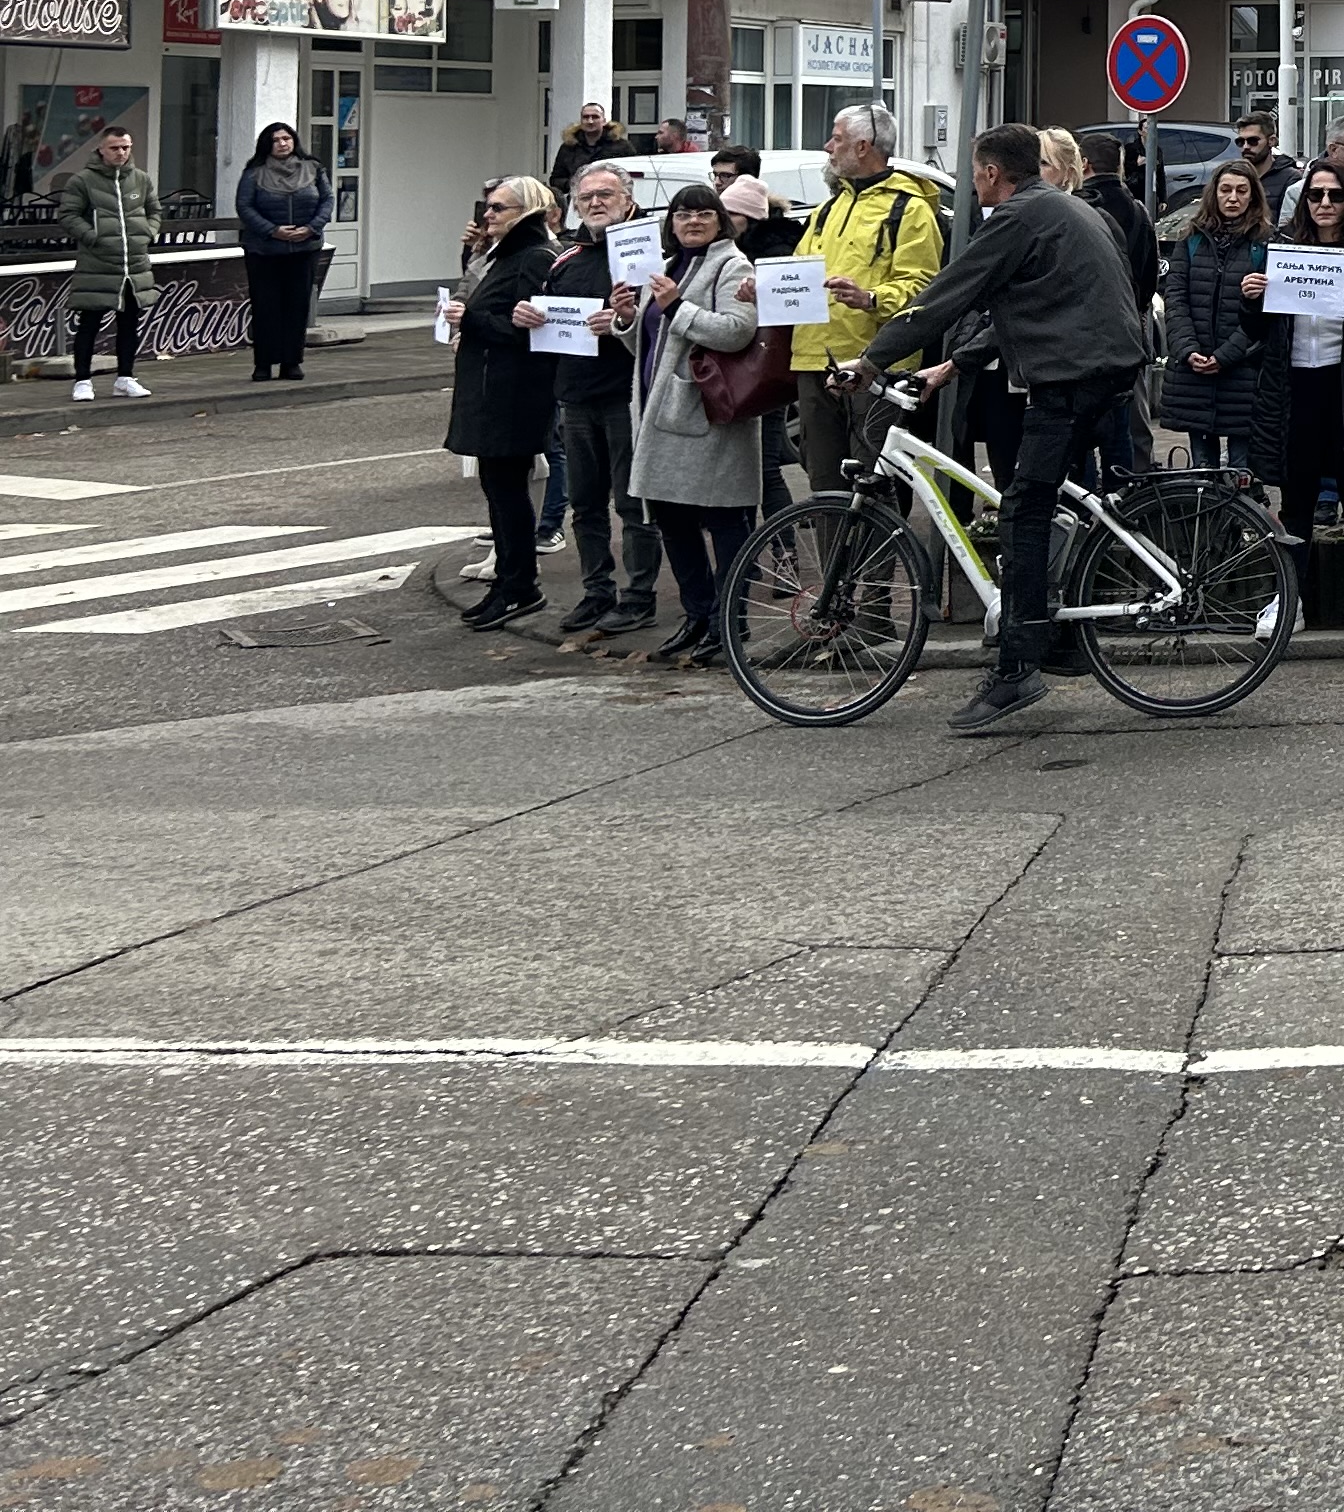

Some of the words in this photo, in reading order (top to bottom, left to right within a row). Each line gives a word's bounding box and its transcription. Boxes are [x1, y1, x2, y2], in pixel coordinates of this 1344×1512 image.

[1276, 261, 1305, 271] САЊА
[1307, 264, 1343, 274] ЋИРИЋ
[1284, 275, 1334, 287] АРБУТИНА
[929, 499, 967, 558] FLYER
